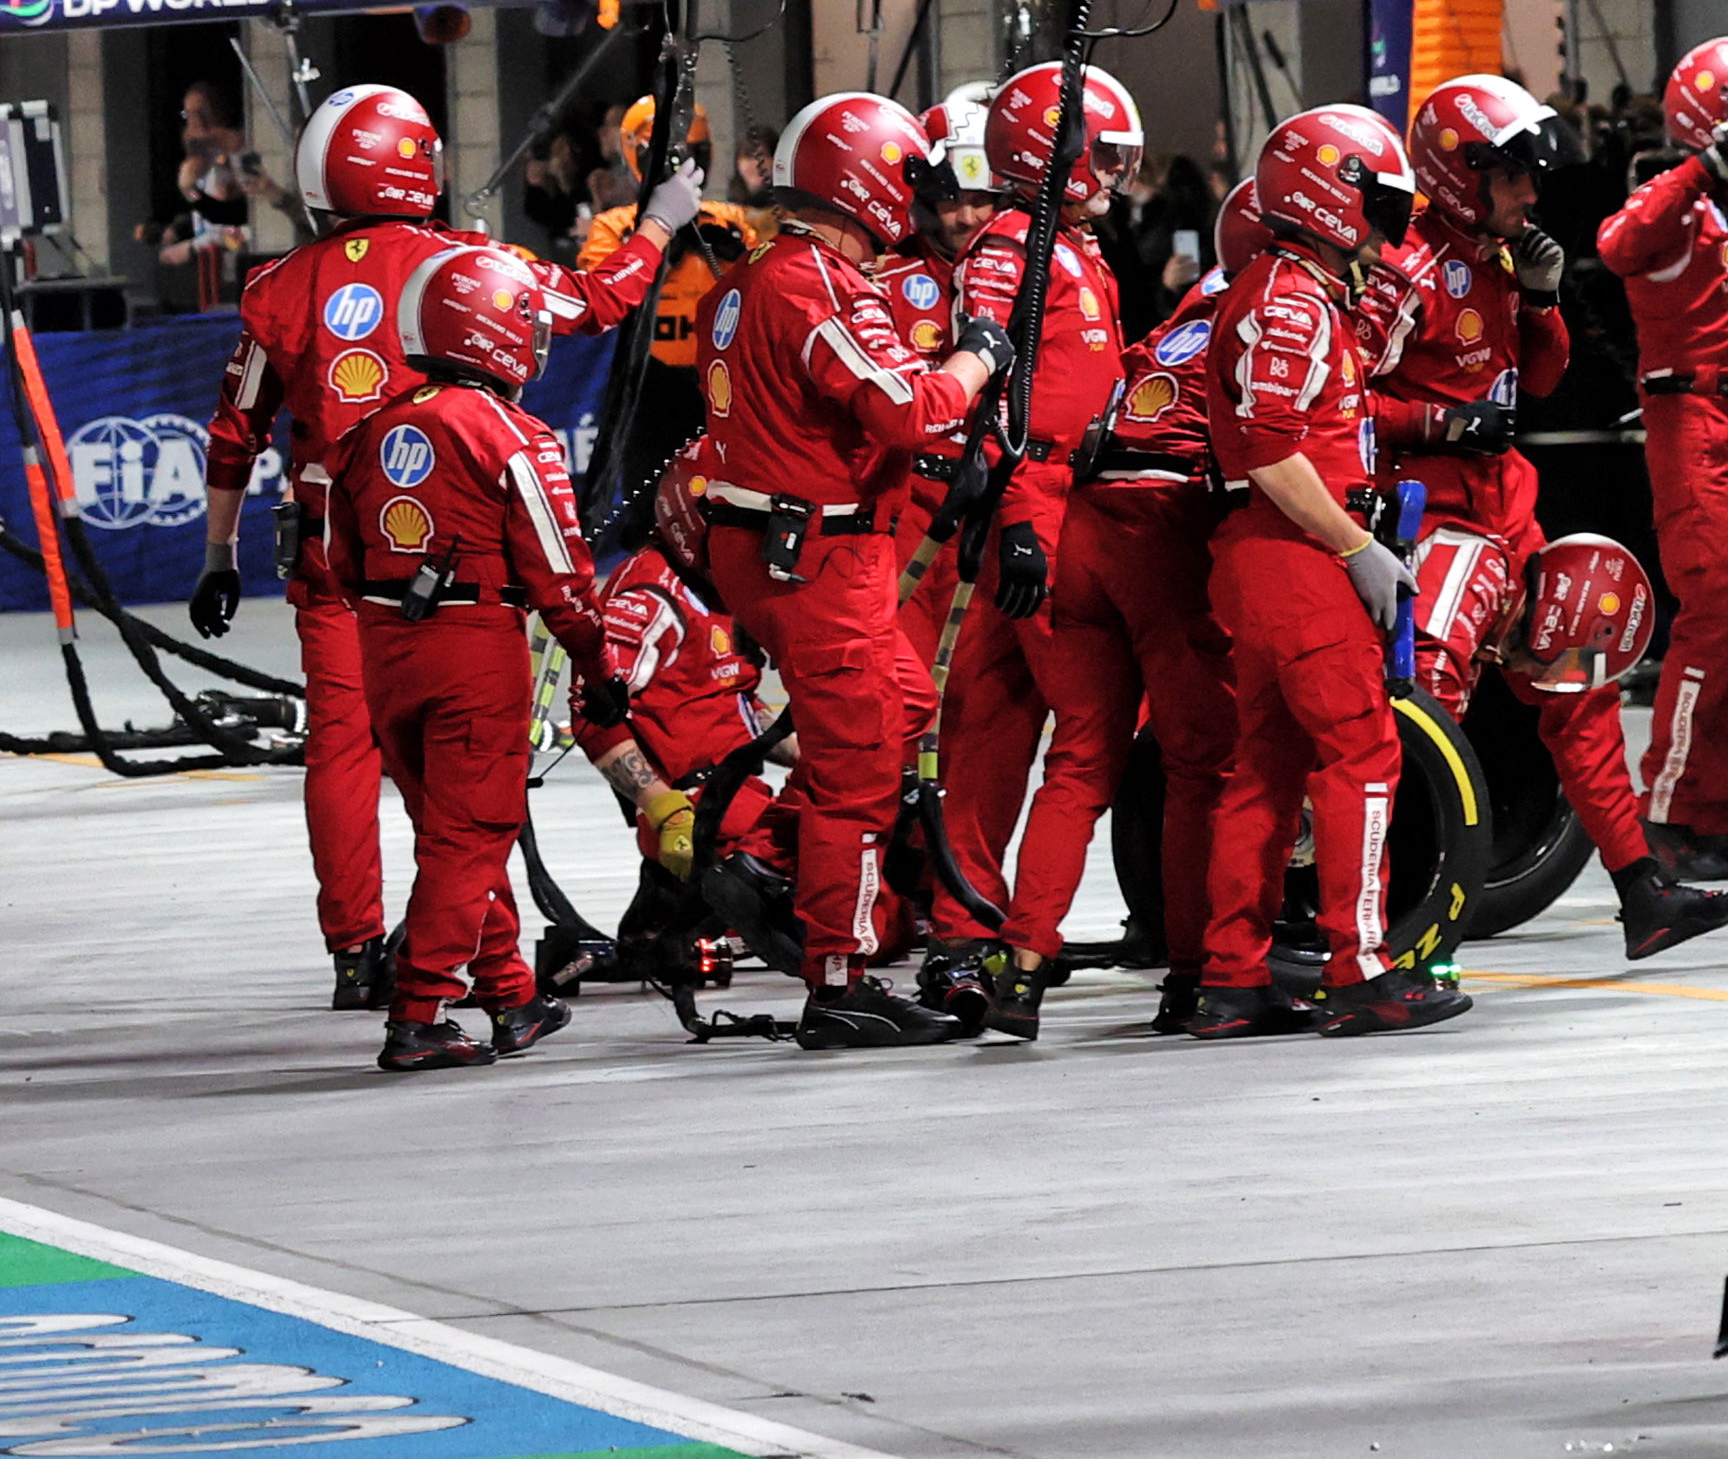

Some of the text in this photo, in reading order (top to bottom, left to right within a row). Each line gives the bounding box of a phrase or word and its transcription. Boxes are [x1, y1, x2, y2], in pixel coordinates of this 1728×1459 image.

[330, 284, 379, 340] hp
[905, 274, 937, 310] hp
[386, 425, 429, 487] hp
